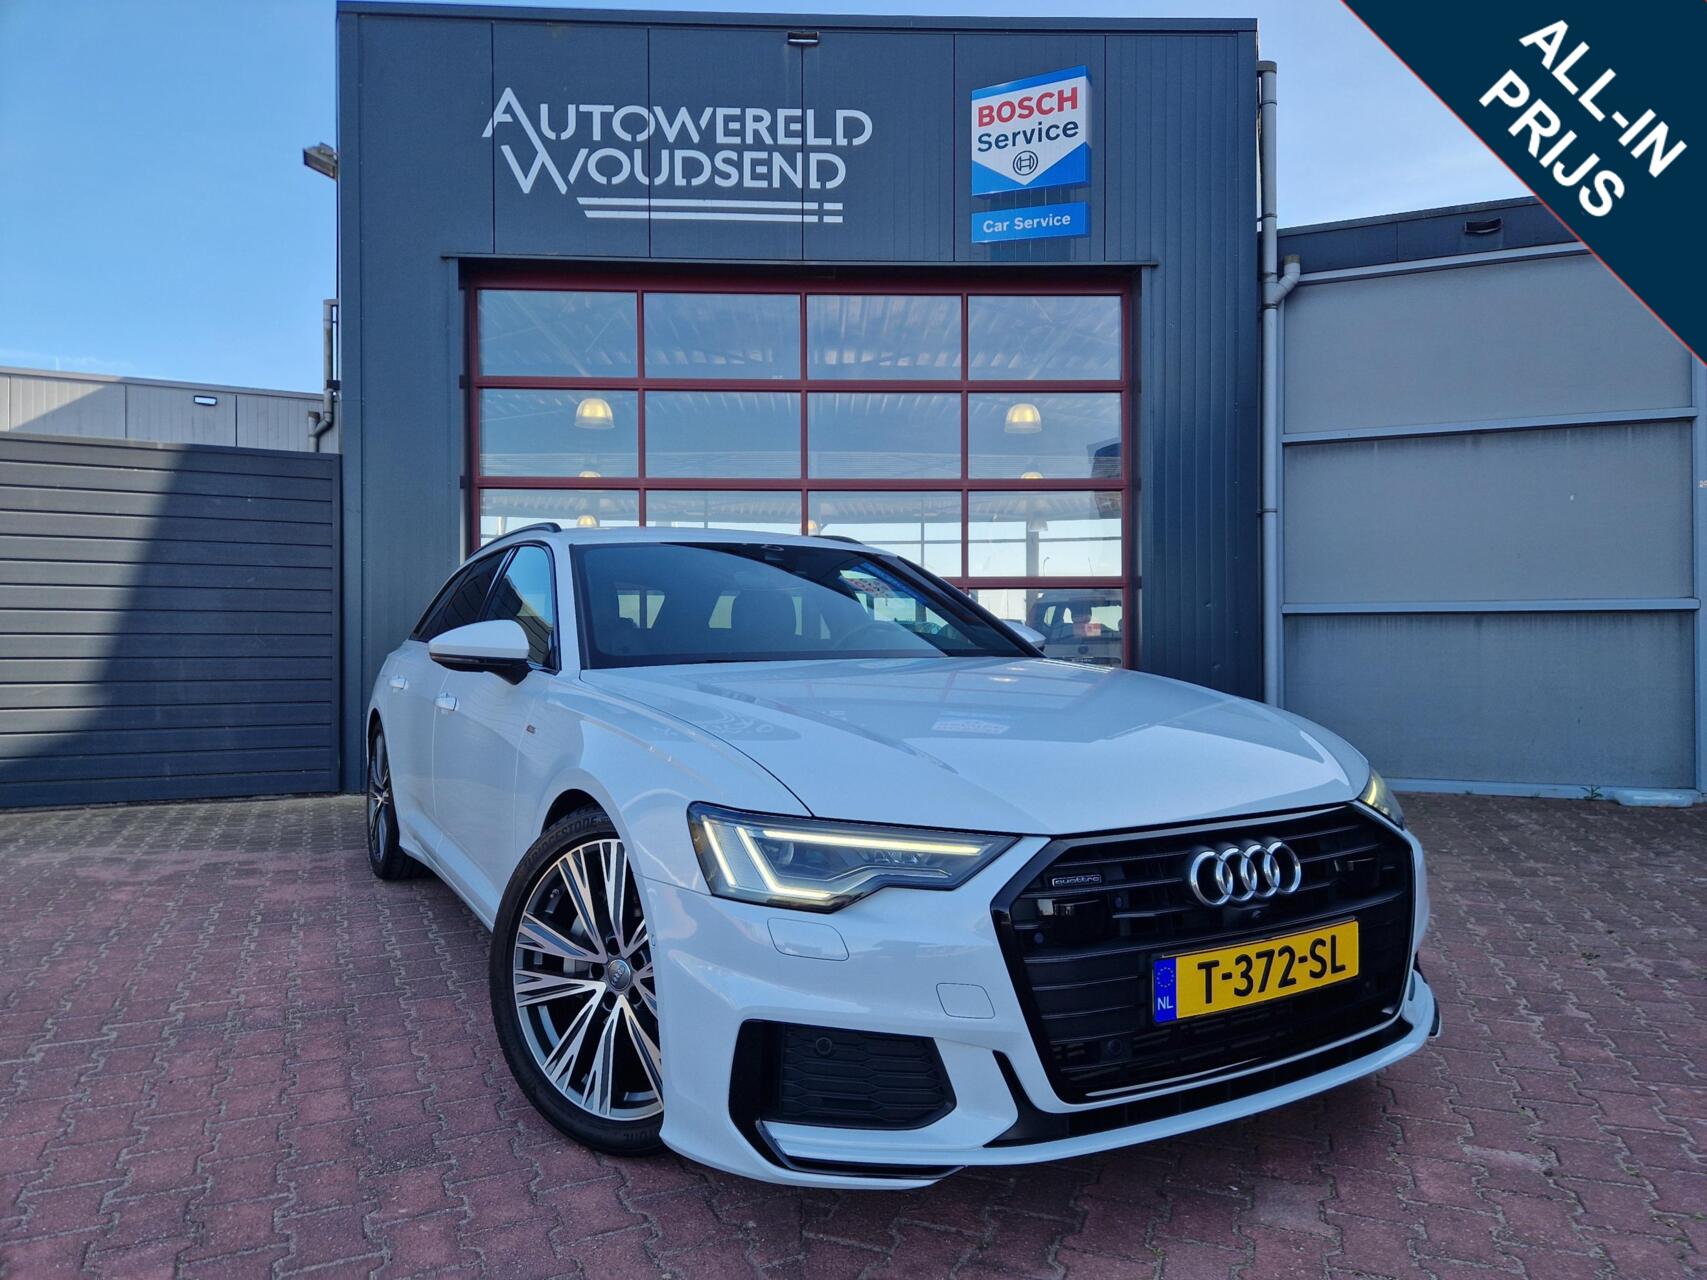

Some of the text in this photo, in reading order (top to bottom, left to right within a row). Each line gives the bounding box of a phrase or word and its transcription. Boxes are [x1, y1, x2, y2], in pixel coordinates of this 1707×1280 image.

[482, 87, 873, 147] AUTOWERELD
[977, 86, 1078, 128] BOSCH
[976, 120, 1079, 153] Service
[500, 145, 847, 195] WOUDSEND
[982, 213, 1072, 233] Car Service
[1196, 934, 1347, 1005] T-372-SL
[1156, 995, 1174, 1011] NL
